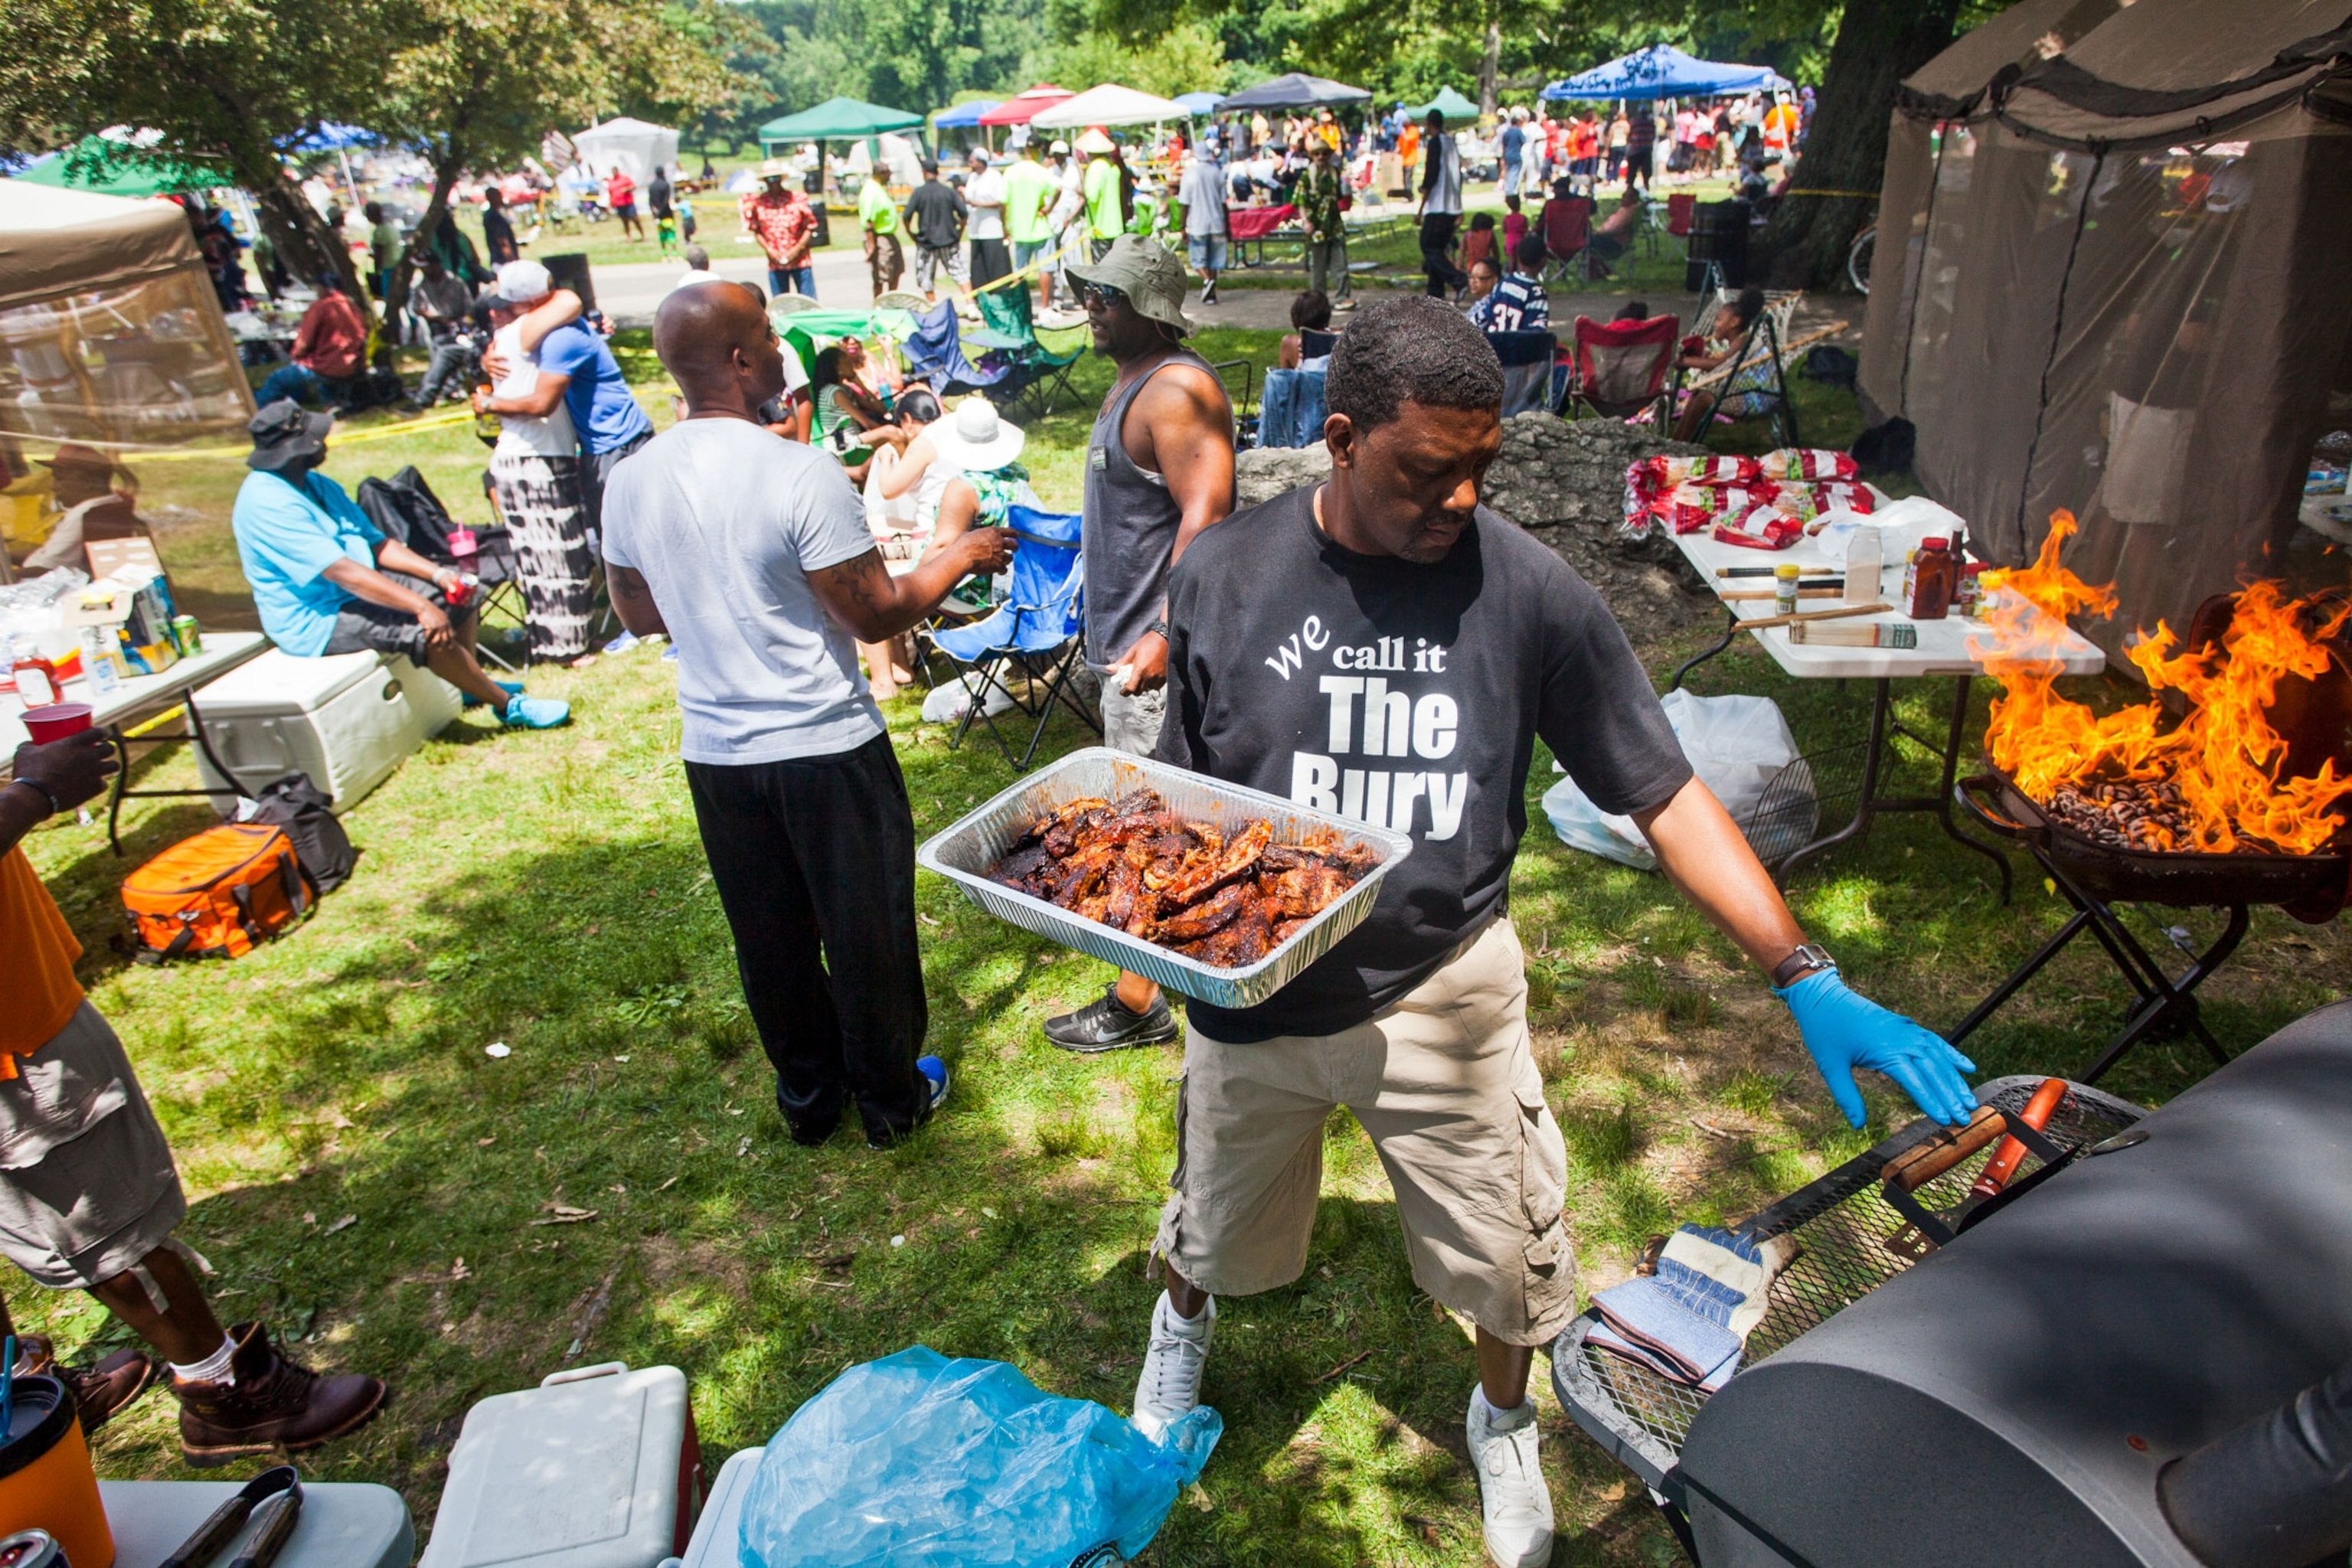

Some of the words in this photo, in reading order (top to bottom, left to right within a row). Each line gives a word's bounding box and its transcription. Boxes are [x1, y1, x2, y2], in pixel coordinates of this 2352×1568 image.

[1488, 303, 1523, 332] 37
[1265, 615, 1330, 681] we
[1333, 635, 1406, 671] call
[1413, 638, 1447, 673] it
[1319, 675, 1458, 759] The
[1291, 751, 1468, 841] Bury
